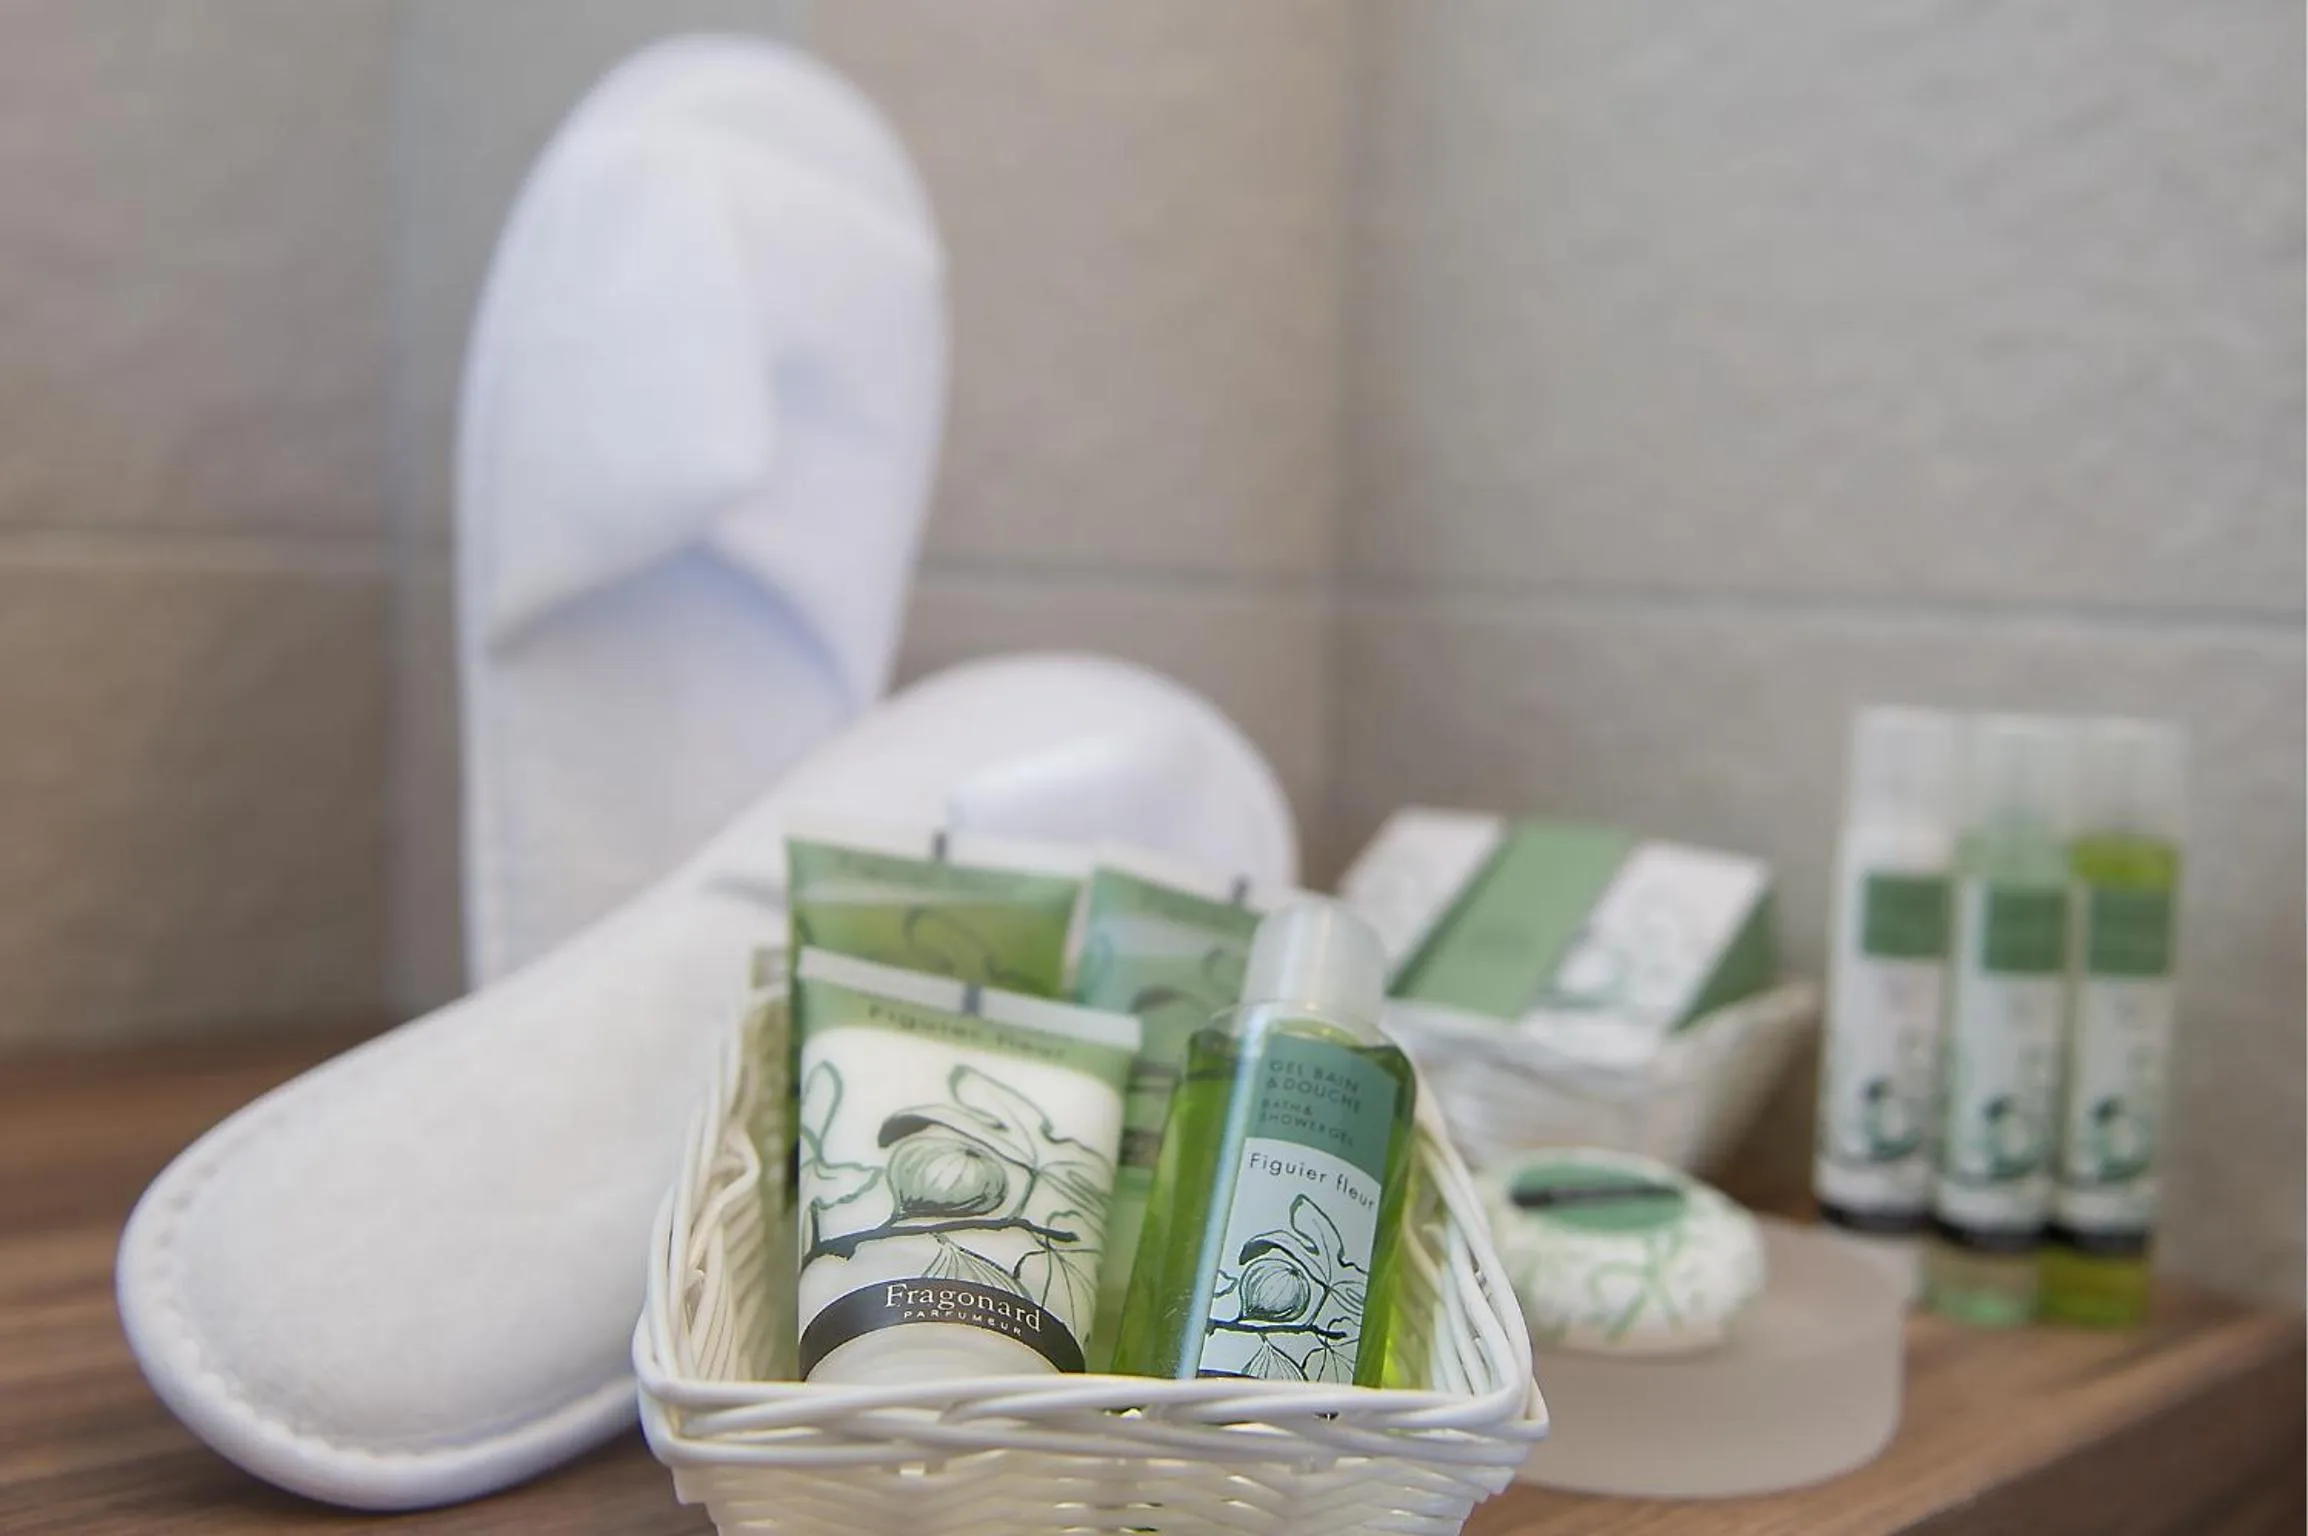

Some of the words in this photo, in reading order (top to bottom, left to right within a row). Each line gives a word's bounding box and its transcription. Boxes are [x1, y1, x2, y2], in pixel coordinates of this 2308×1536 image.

[1269, 1060, 1303, 1077] GEL
[1314, 1067, 1360, 1094] BAIN
[1249, 1152, 1328, 1183] Figuier
[1336, 1173, 1376, 1211] fleur
[884, 1283, 1042, 1333] Fragonard
[903, 1310, 1022, 1337] PARFUMEUR
